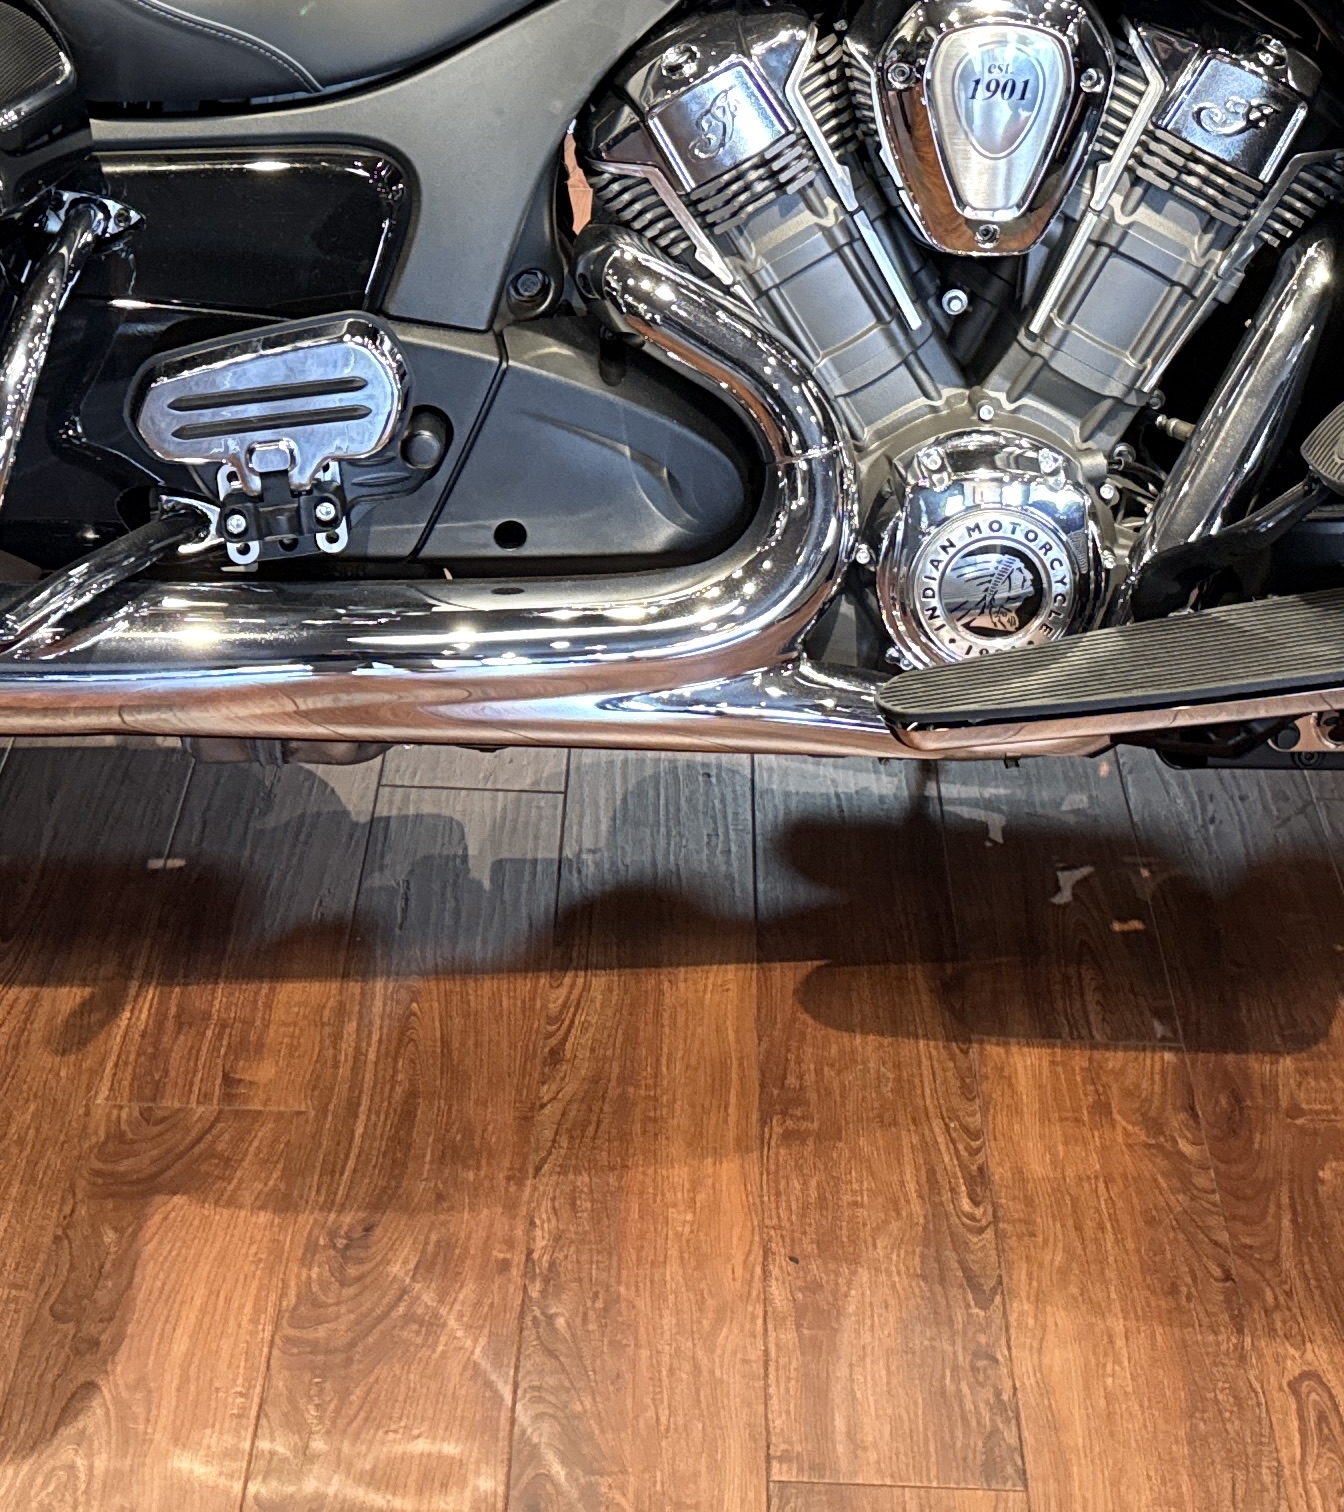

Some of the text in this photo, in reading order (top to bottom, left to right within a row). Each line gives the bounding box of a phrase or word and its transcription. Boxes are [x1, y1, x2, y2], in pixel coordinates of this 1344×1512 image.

[968, 61, 1030, 101] est. 1901
[922, 520, 1068, 637] INDIAN MOTORCYCLE
